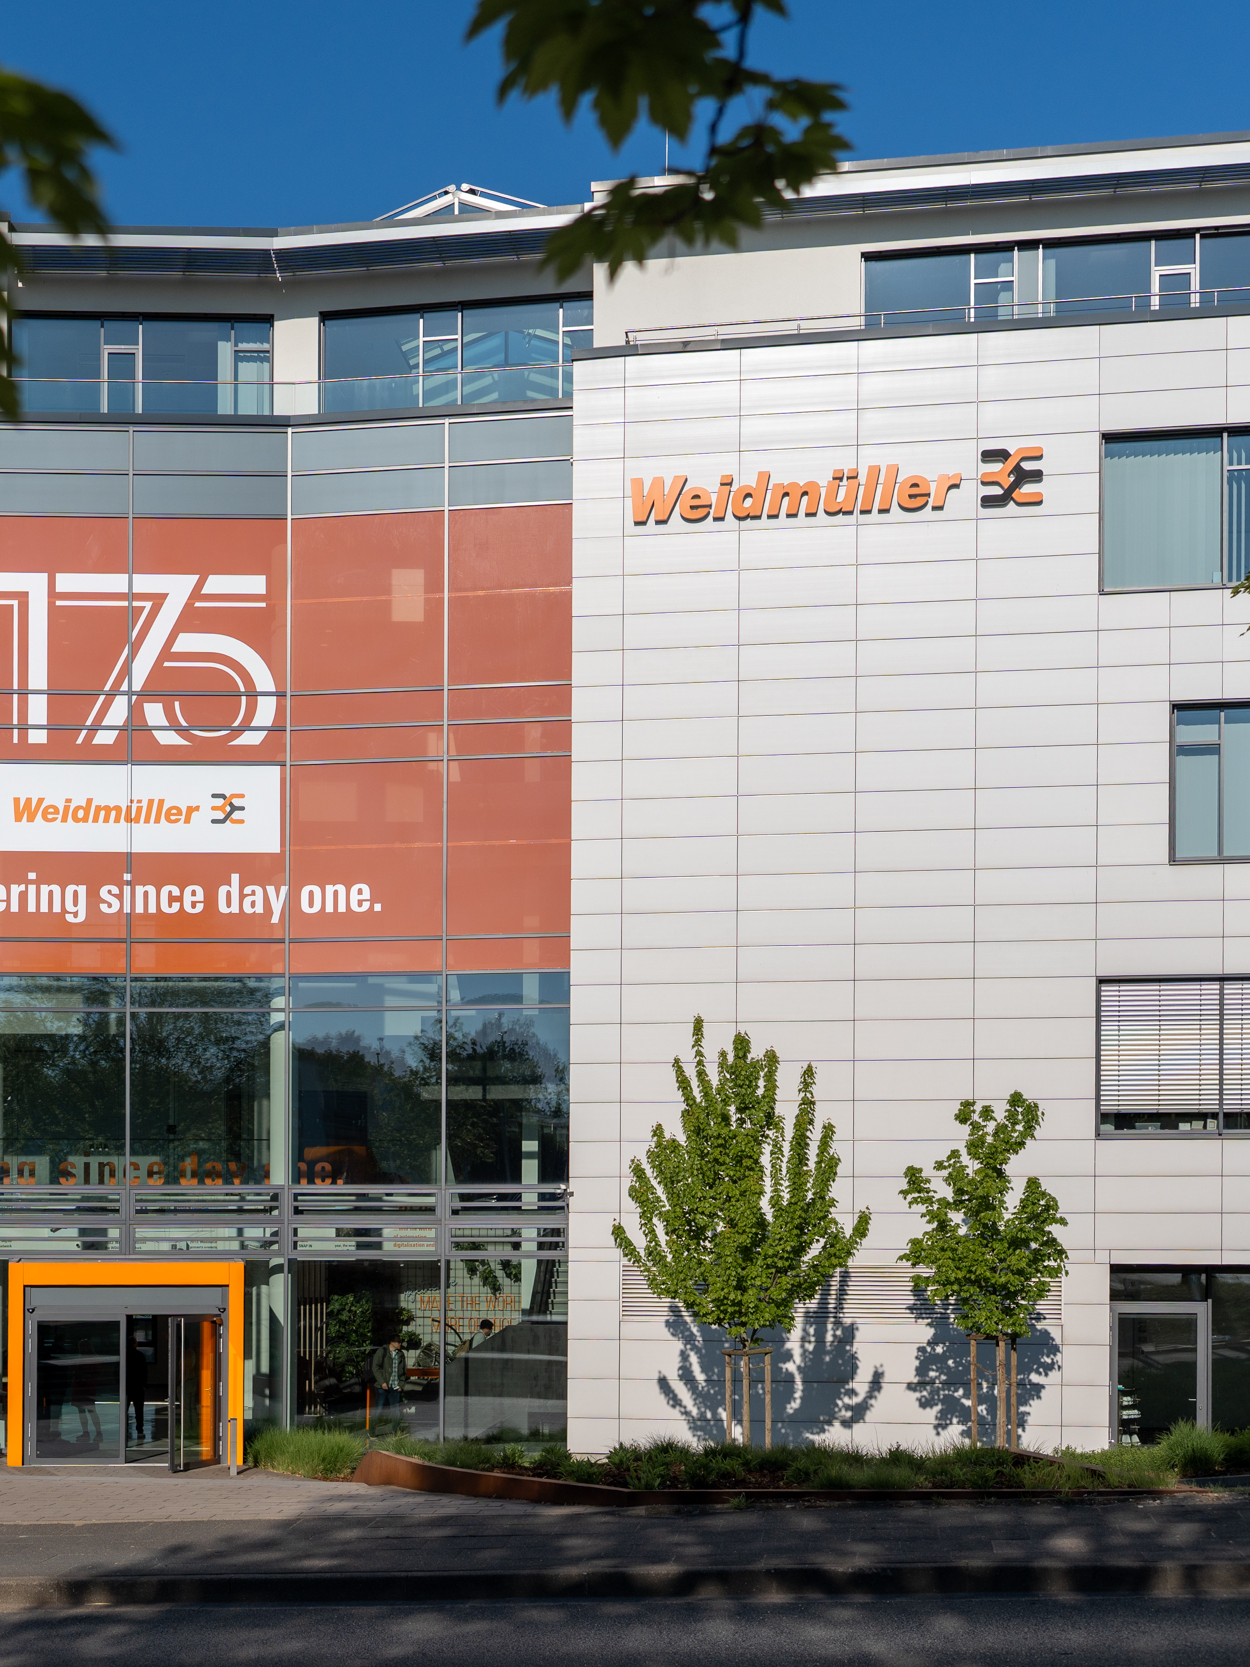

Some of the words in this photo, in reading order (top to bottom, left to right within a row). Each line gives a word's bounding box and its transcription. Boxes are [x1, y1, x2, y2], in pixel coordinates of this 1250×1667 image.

[630, 463, 962, 525] Weidmüller
[12, 796, 200, 825] Weidmüller
[99, 873, 204, 914] since
[217, 873, 290, 924] day
[300, 882, 383, 913] one.
[458, 1294, 481, 1311] THE
[485, 1294, 522, 1311] WORL
